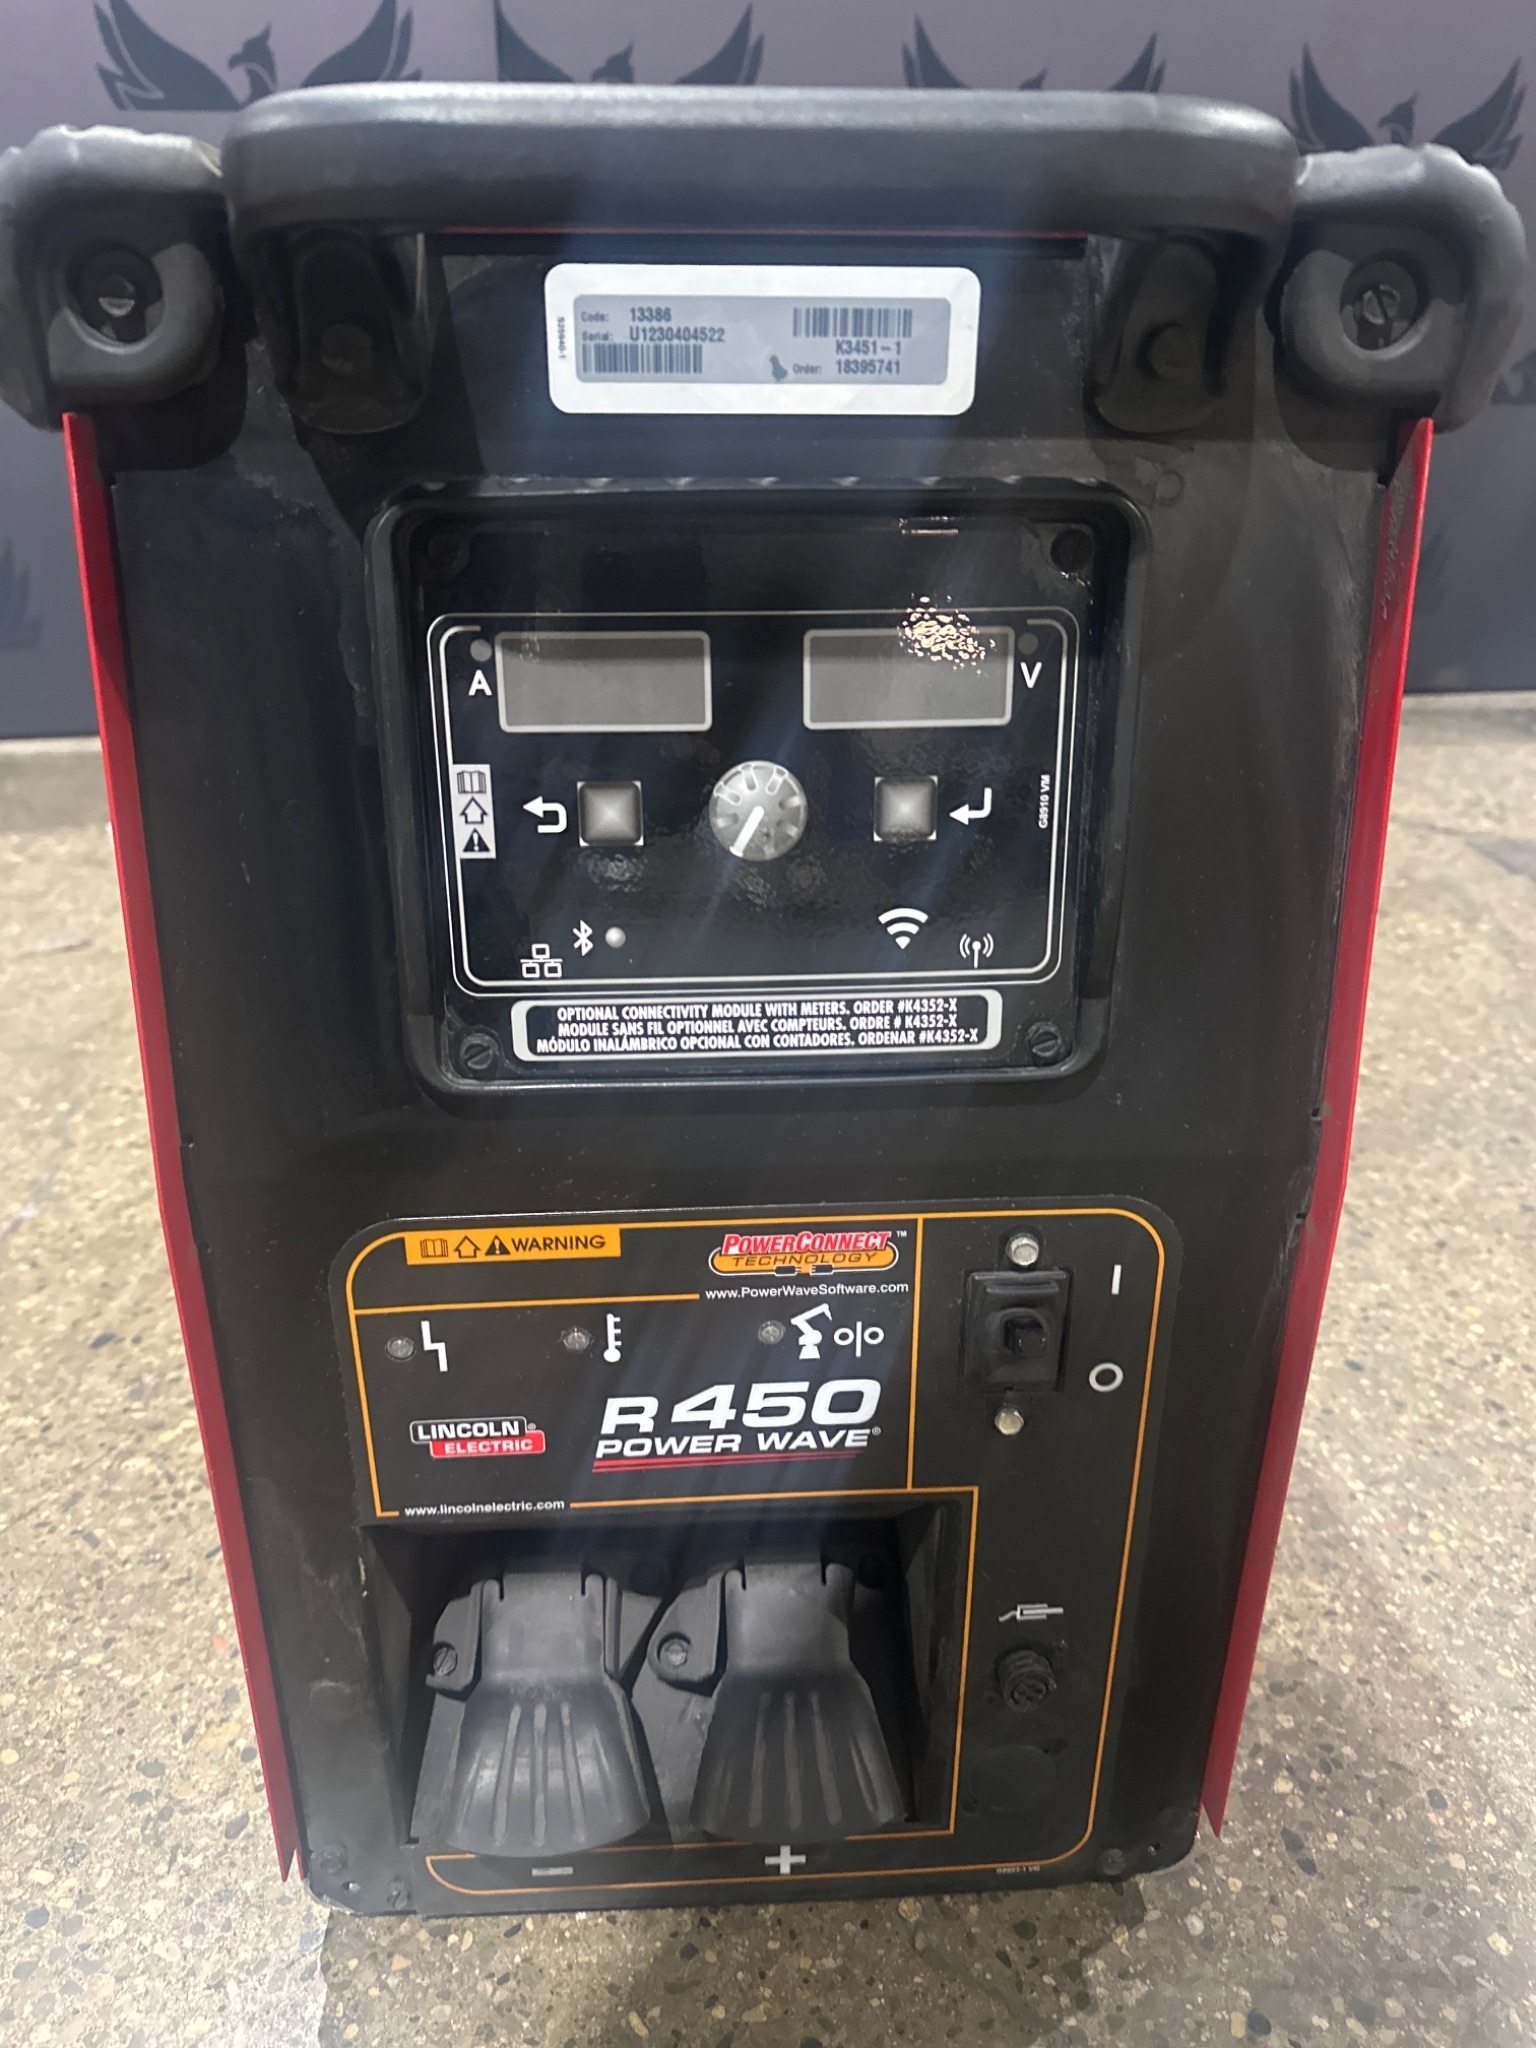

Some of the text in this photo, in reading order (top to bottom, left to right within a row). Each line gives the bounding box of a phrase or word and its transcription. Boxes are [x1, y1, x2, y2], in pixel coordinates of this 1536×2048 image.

[629, 307, 672, 322] 13386
[629, 326, 725, 343] U1230404522
[792, 359, 901, 375] Order: 18395741
[468, 668, 493, 697] A
[1020, 661, 1042, 689] V
[1040, 774, 1051, 793] VM
[557, 997, 958, 1022] OPTIONAL CONNECTIVITY MODULE WITH METERS. ORDER #K4352-X
[558, 1013, 958, 1038] MODULE SANS FIL OPTIONNEL AVEC COMPTEURS. ORDRE # K4352-X
[536, 1028, 979, 1054] MÓDULO INALÁMBRICO OPCIONAL CON CONTADORES. ORDENAR #K4352-X
[511, 1234, 607, 1253] WARNING
[732, 1252, 878, 1268] TECHNOLOGY
[705, 1281, 910, 1300] www.PowerWaveSoftware.com
[416, 1419, 521, 1441] LINCOLN
[444, 1438, 534, 1455] ELECTRIC
[595, 1433, 743, 1459] POWER
[404, 1500, 565, 1518] www.lincolnelectric.com
